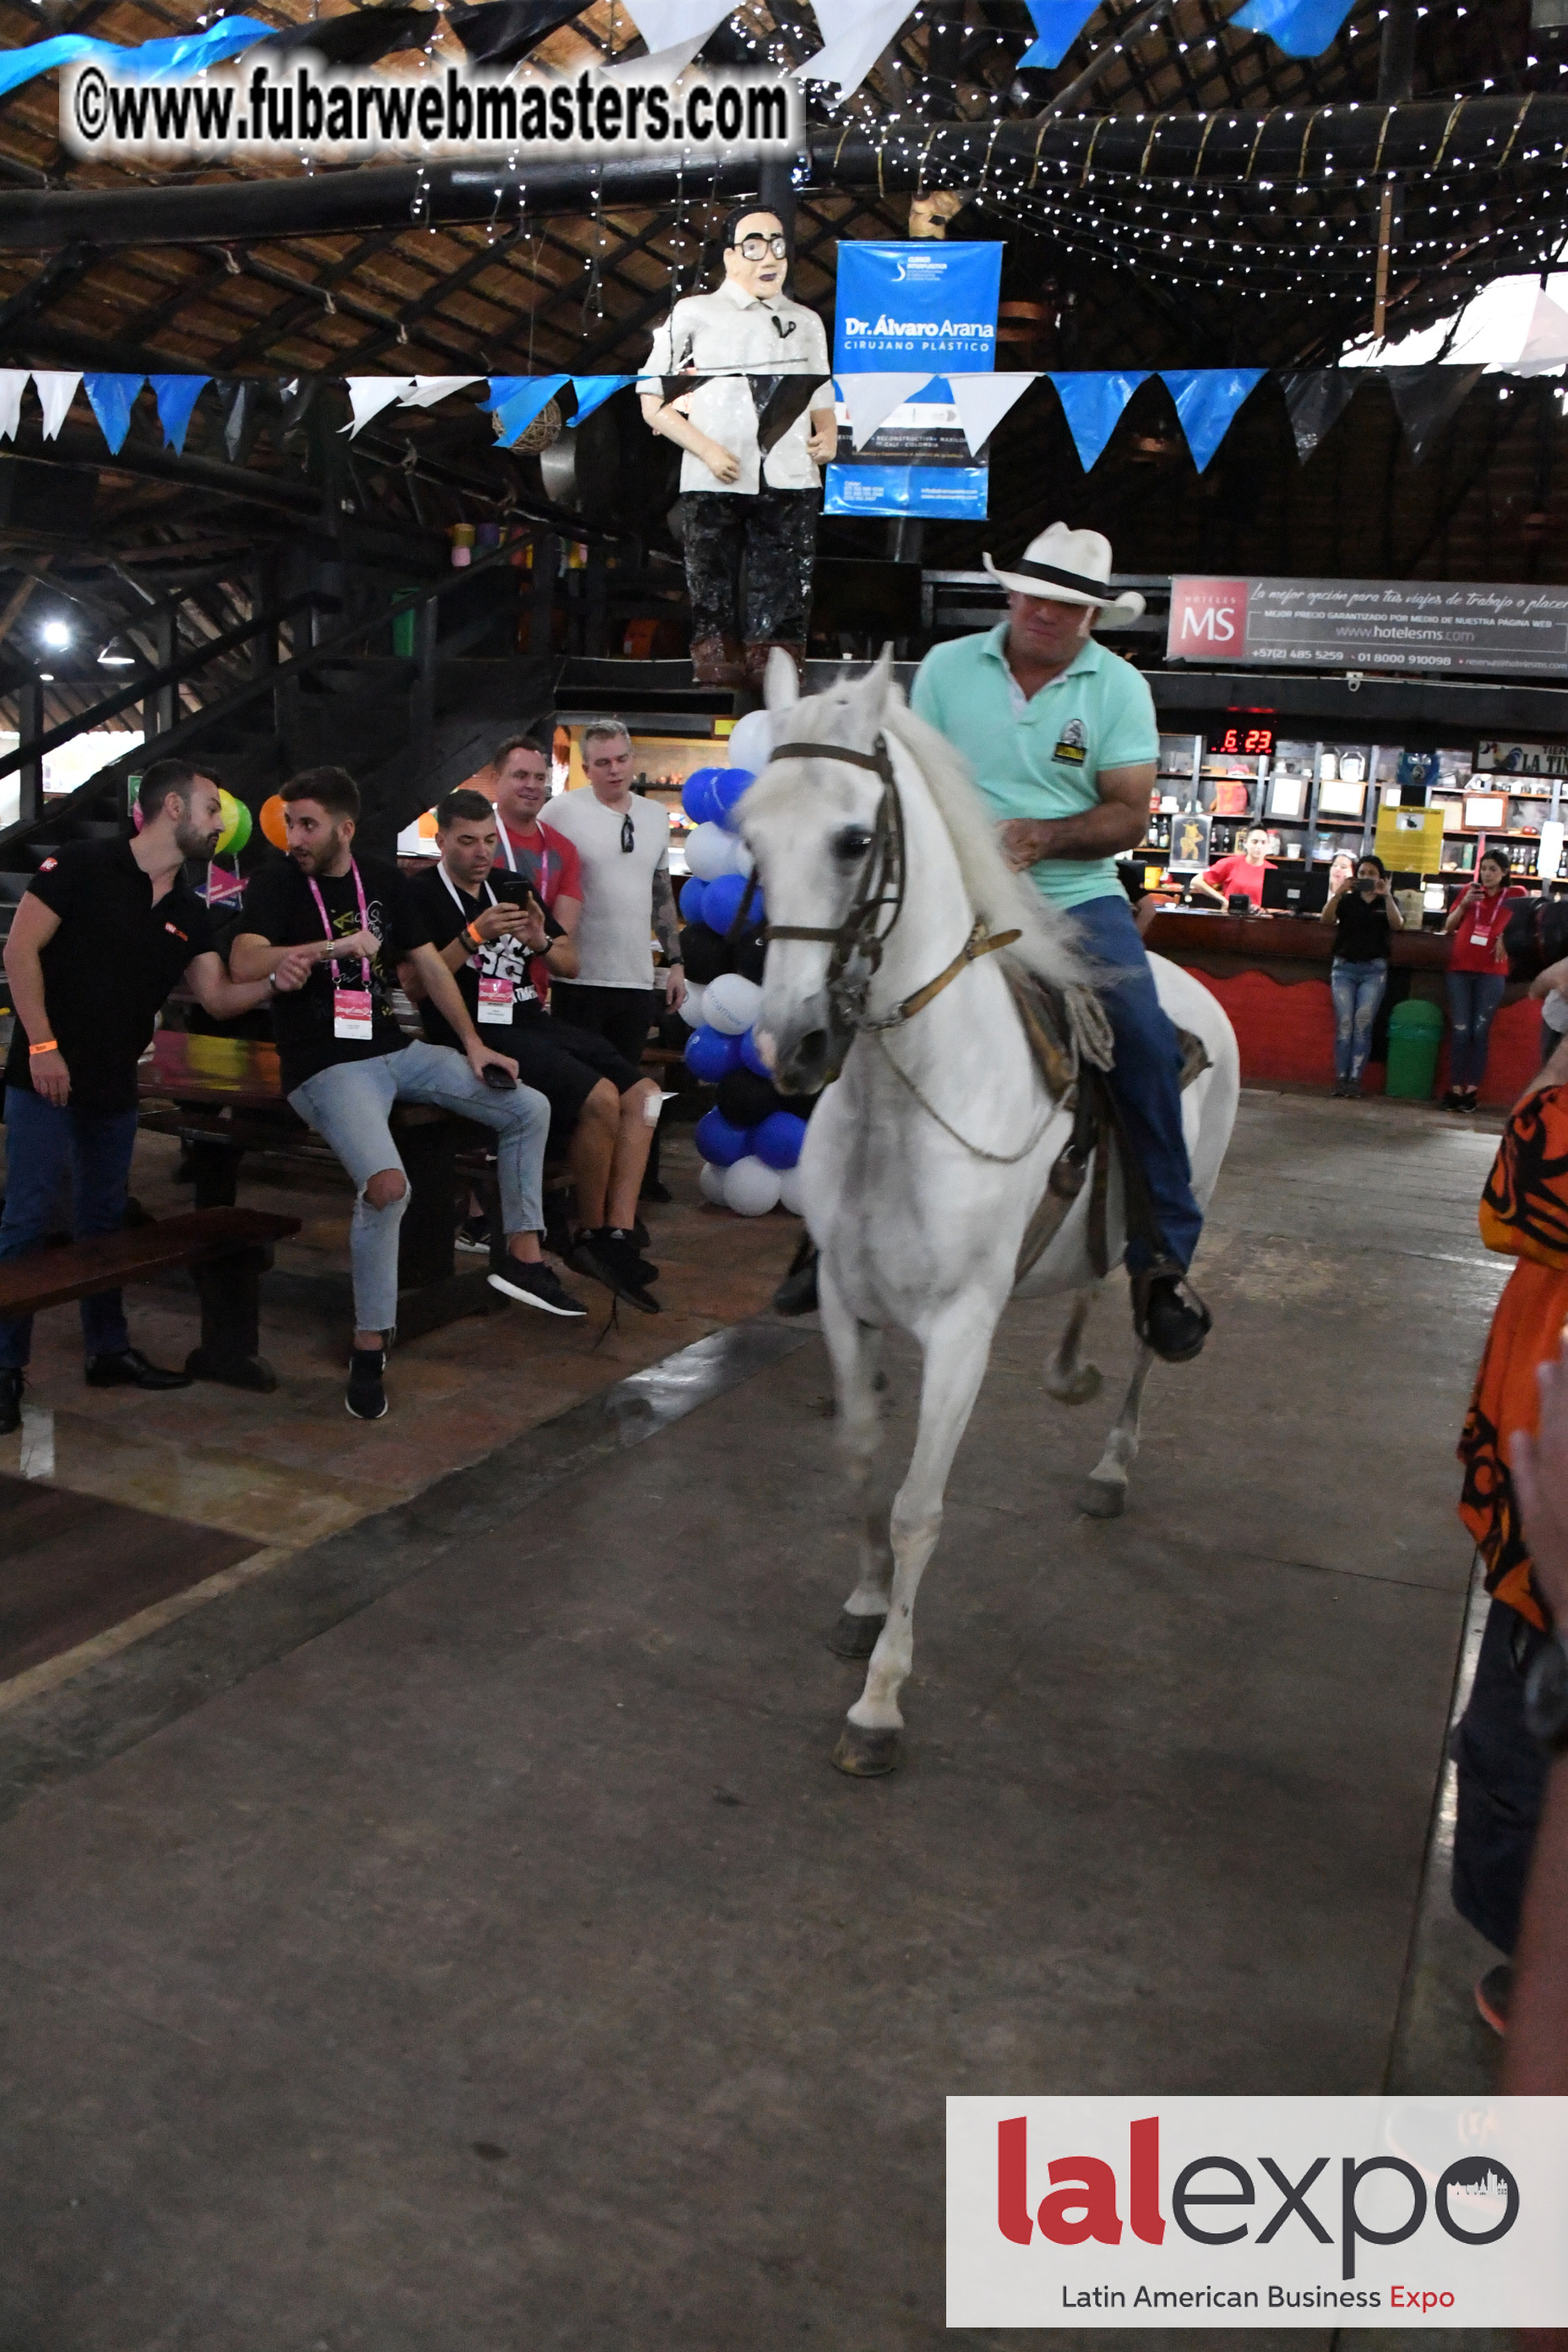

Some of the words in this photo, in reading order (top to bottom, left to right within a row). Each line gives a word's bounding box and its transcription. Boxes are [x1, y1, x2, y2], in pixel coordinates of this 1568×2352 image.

[874, 314, 939, 336] Álvaro
[939, 319, 994, 338] Arana
[844, 340, 914, 351] CIRUJANO
[922, 341, 989, 352] PLÁSTICO
[1184, 596, 1236, 605] HOTELES
[1250, 583, 1266, 601] La
[1269, 589, 1304, 605] mejor
[1309, 590, 1348, 606] opción
[1346, 592, 1380, 607] para
[1405, 593, 1442, 610] viajes
[1446, 592, 1463, 605] de
[1523, 595, 1568, 614] placer
[1181, 607, 1235, 641] MS
[1265, 610, 1293, 618] MEJOR
[1294, 611, 1326, 619] PRECIO
[1327, 612, 1388, 622] GARANTIZADO
[1411, 615, 1440, 623] MEDIO
[1455, 618, 1495, 626] NUESTRA
[1336, 625, 1475, 642] www.hotelesms.com
[1251, 647, 1287, 659] +57(2)
[1290, 650, 1313, 659] 485
[1315, 651, 1344, 661] 5259
[1358, 652, 1371, 662] 01
[1375, 653, 1406, 664] 8000
[1408, 655, 1451, 666] 910098
[1522, 754, 1540, 772] LA
